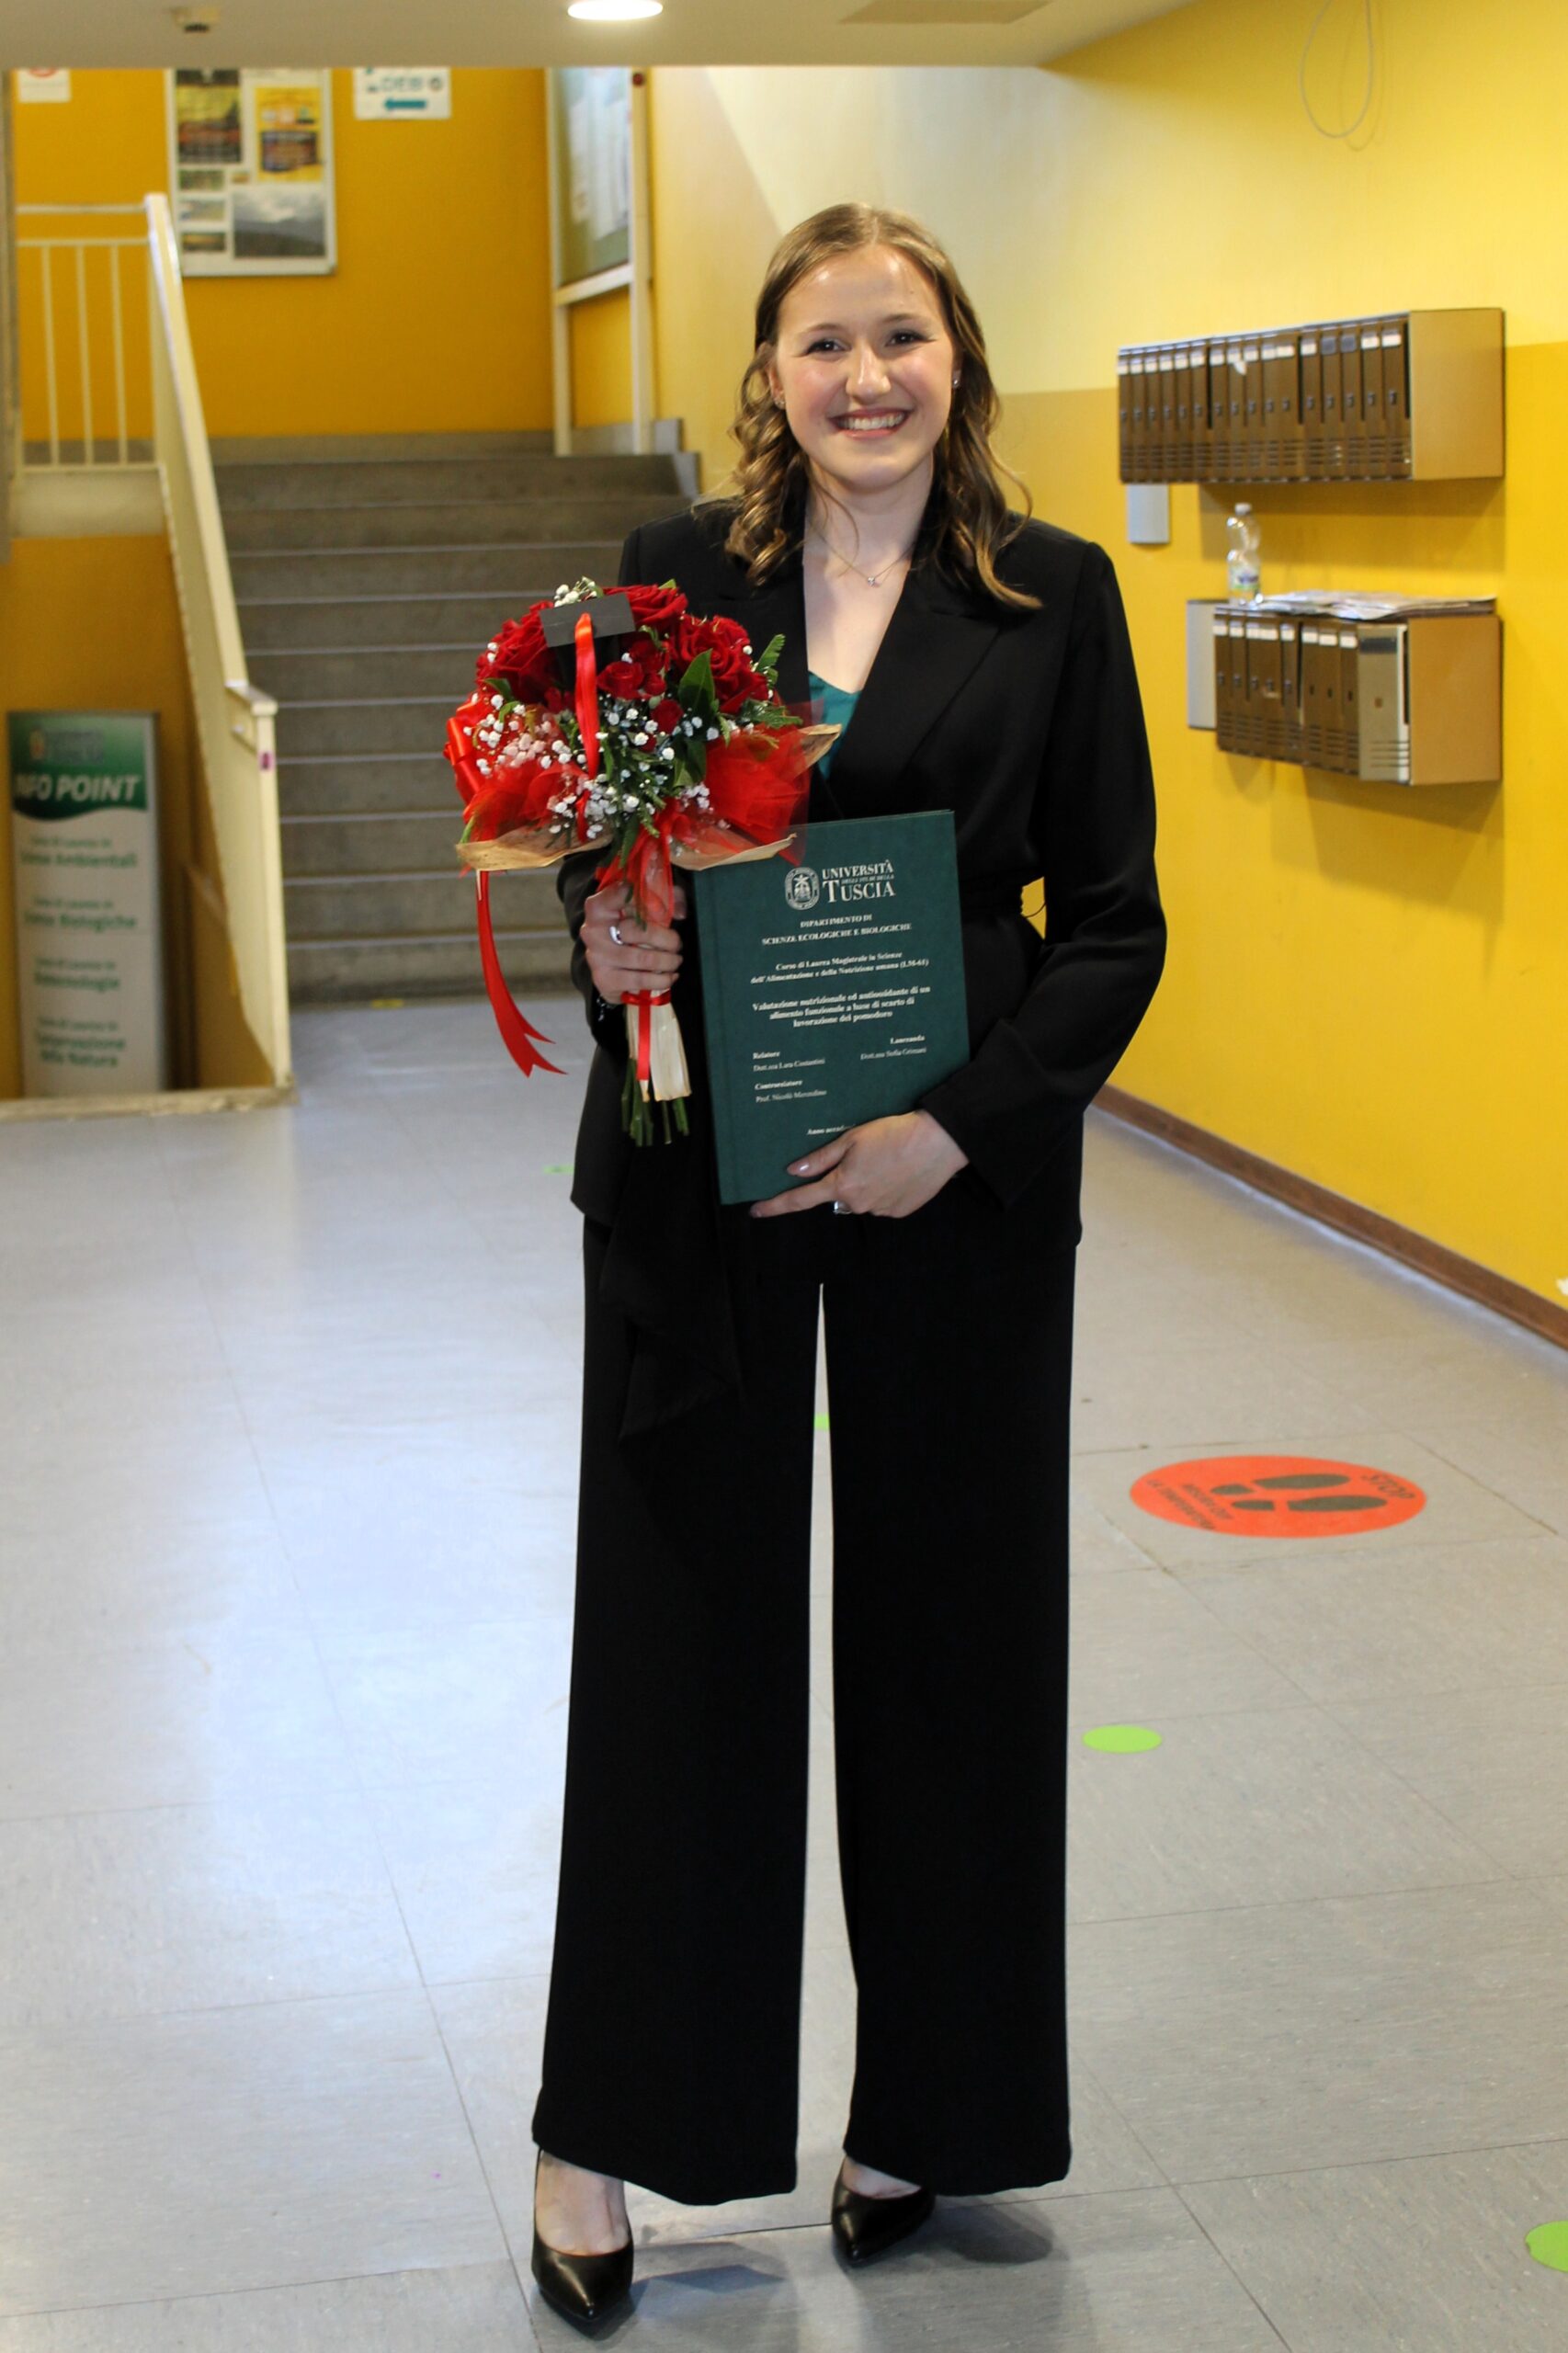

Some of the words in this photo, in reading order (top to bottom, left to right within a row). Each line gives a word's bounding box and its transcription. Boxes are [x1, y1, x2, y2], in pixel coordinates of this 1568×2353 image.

[55, 775, 139, 801] POINT
[822, 858, 894, 880] UNIVERSITÀ
[822, 880, 896, 903] TUSCIA
[800, 915, 862, 928] DIPARTIMENTO
[863, 914, 872, 922] DI
[762, 936, 797, 946] SCIENZE
[798, 929, 852, 941] ECOLOGICHE
[861, 923, 912, 935] BIOLOGICHE
[776, 962, 796, 971] Corso
[806, 959, 831, 968] Laurea
[832, 956, 868, 966] Magistrale
[877, 952, 903, 961] Scienze
[820, 968, 837, 976] della
[838, 966, 874, 974] Nutrizione
[875, 962, 899, 971] umana
[752, 1000, 799, 1011] Valutazione
[800, 995, 846, 1006] nutrizionale
[847, 993, 858, 1001] ed
[910, 986, 918, 995] di
[769, 1010, 803, 1019] alimento
[805, 1005, 845, 1016] funzionale
[853, 1003, 870, 1011] base
[871, 1000, 880, 1008] di
[881, 998, 905, 1007] scarto
[906, 997, 915, 1006] di
[793, 1017, 838, 1028] lavorazione
[839, 1014, 852, 1022] del
[853, 1010, 893, 1023] pomodoro
